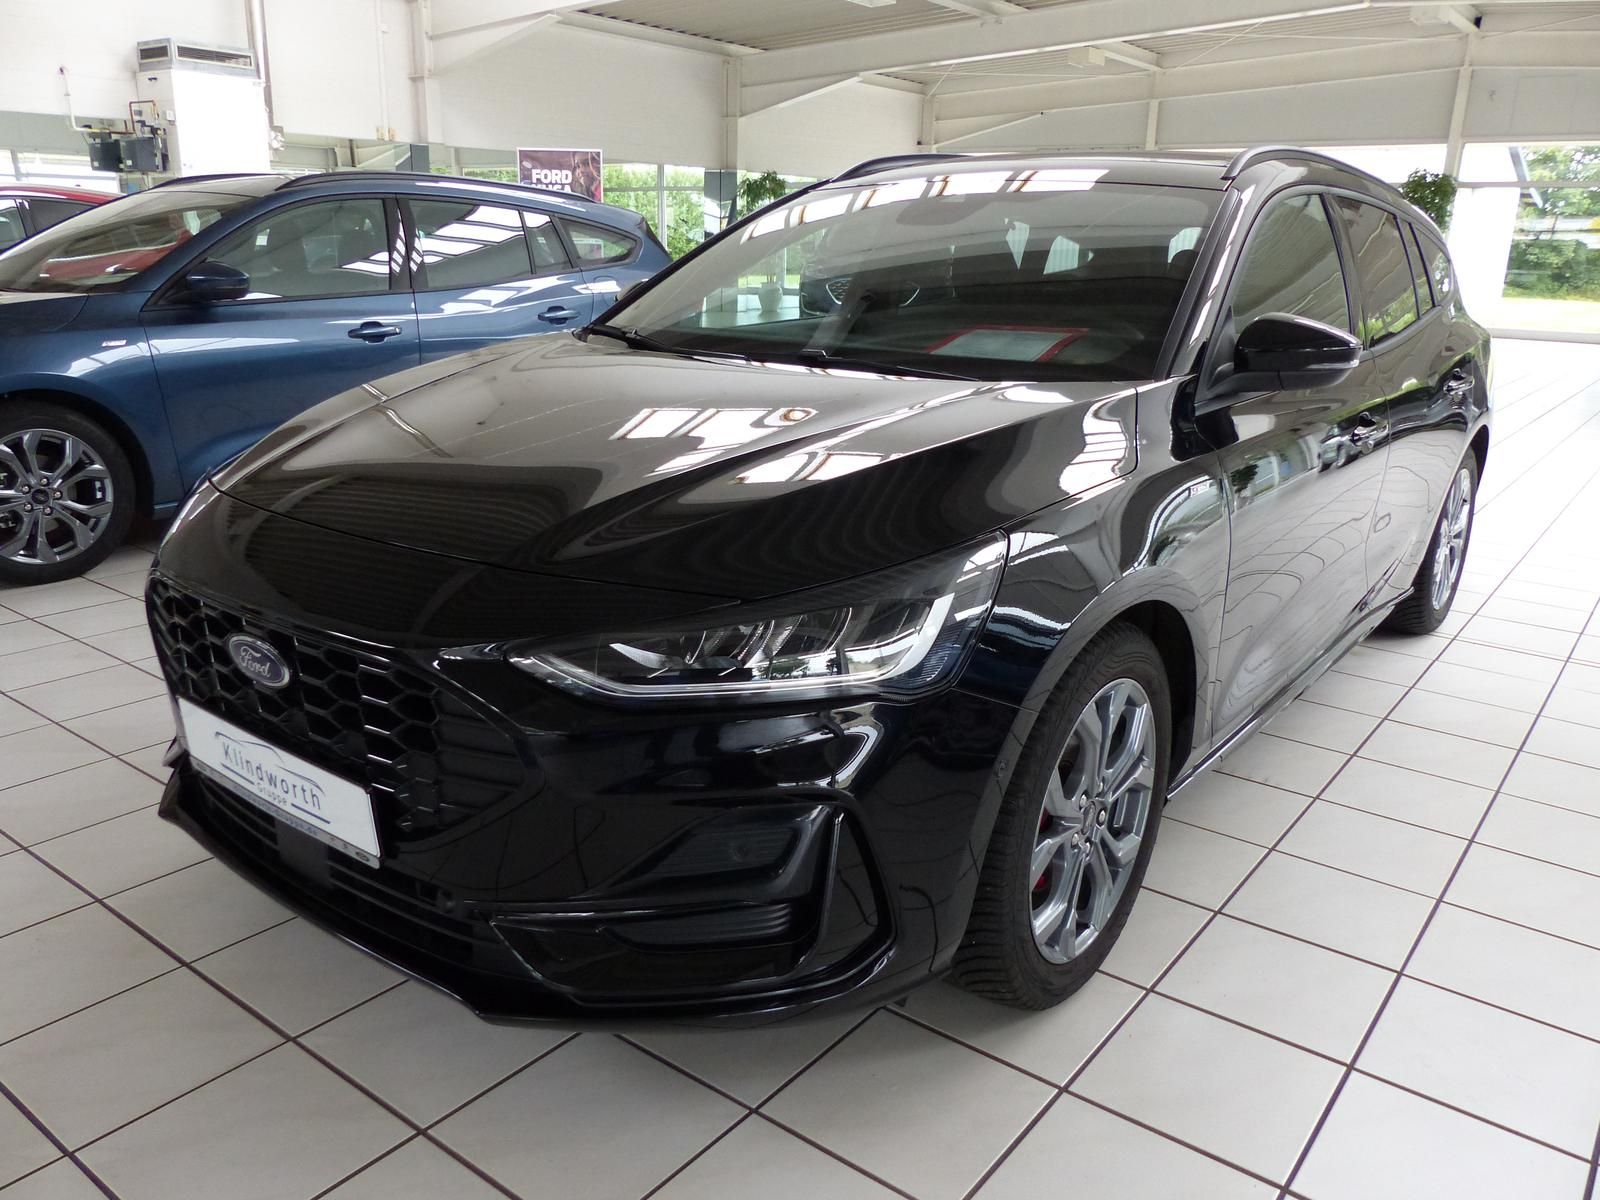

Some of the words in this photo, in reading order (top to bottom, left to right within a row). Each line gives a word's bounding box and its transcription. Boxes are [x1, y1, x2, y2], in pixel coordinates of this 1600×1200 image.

[531, 168, 573, 184] FORD
[240, 645, 271, 677] Ford
[222, 742, 321, 810] Klindworth
[256, 782, 288, 806] Gruppe
